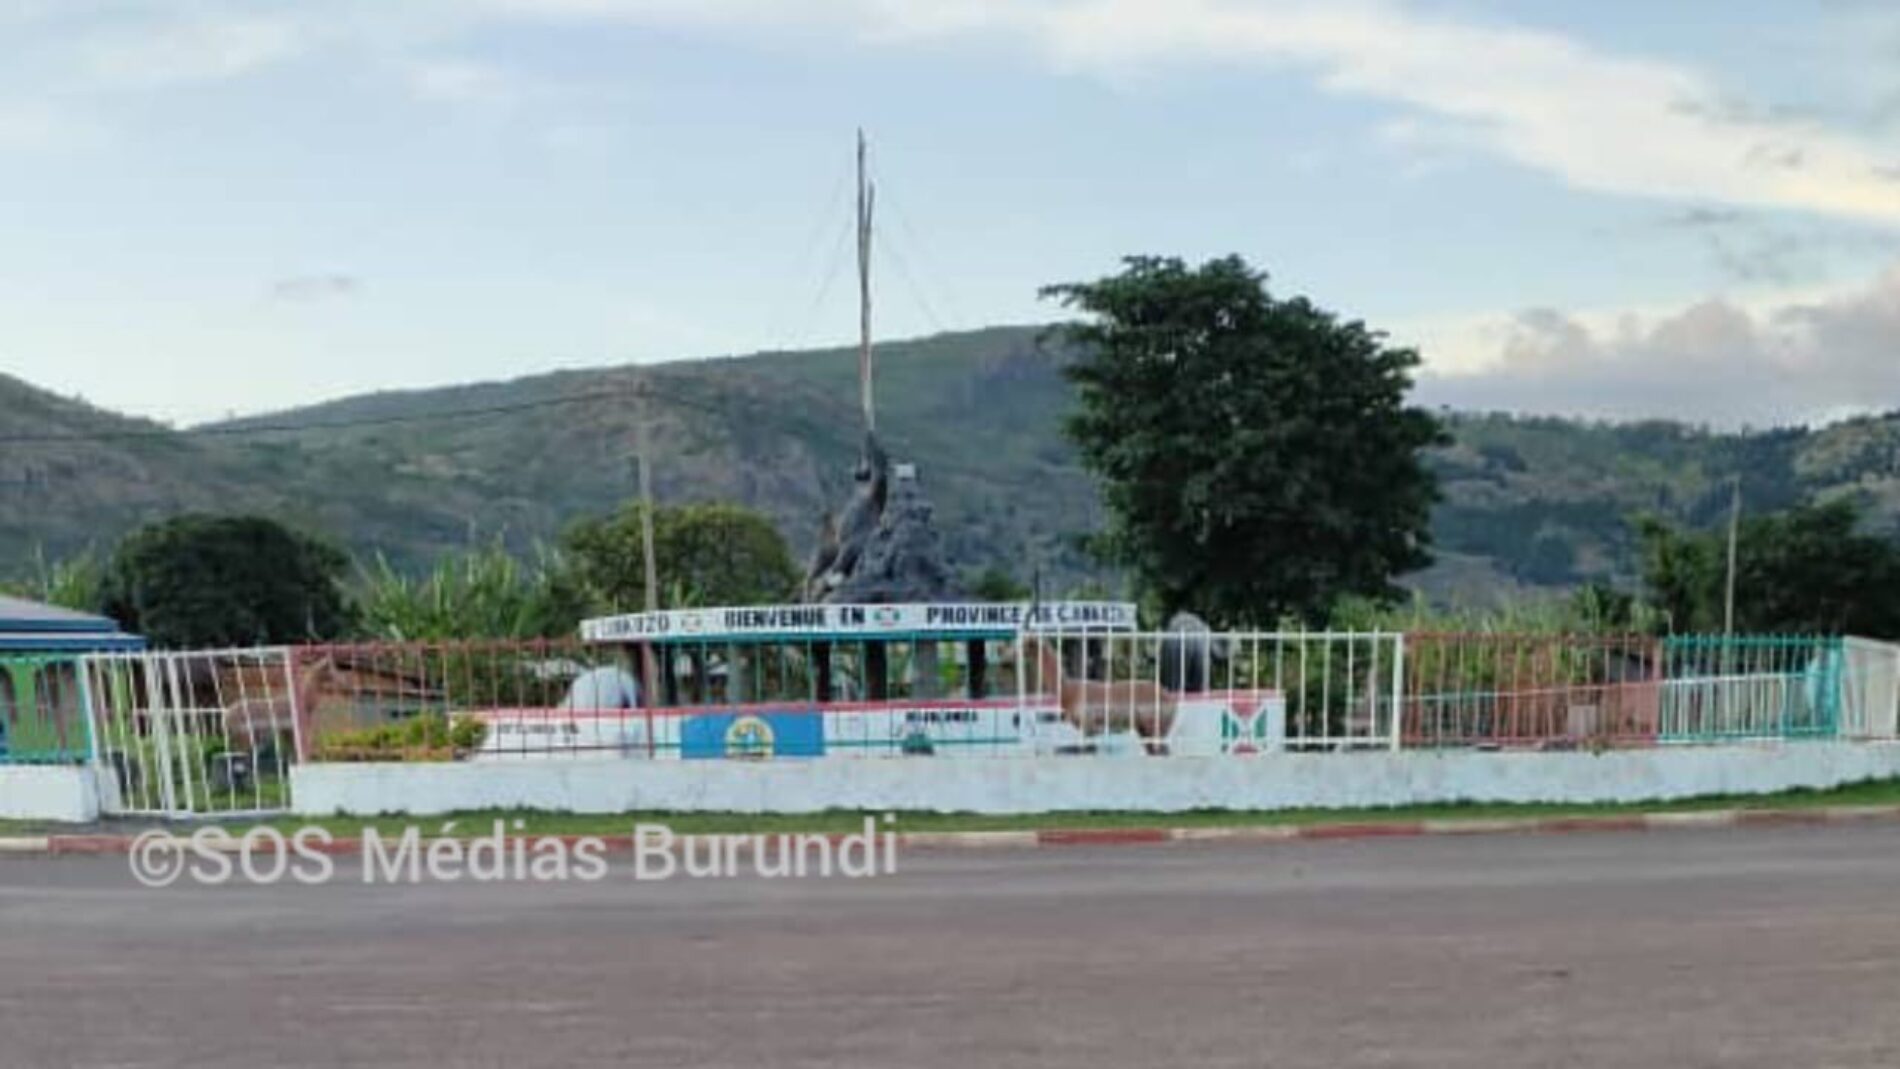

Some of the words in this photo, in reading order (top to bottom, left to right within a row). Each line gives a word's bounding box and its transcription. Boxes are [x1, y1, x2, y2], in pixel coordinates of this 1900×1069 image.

[724, 607, 826, 629] BIENVENUE
[840, 606, 866, 625] EN
[926, 606, 1020, 625] PROVINCE
